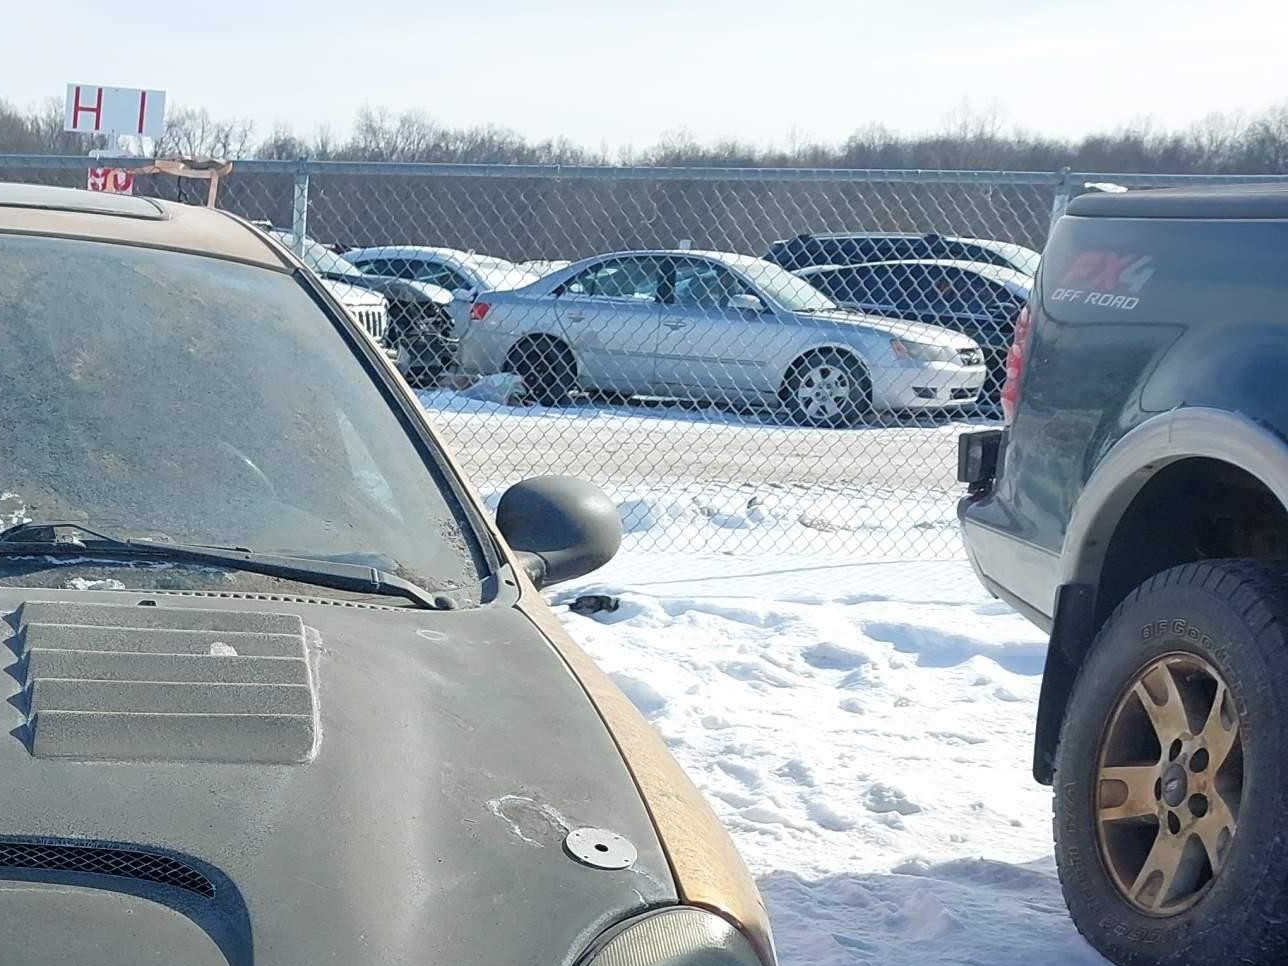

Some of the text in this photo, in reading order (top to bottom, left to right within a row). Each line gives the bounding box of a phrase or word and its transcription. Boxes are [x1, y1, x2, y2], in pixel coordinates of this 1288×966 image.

[72, 85, 103, 131] H
[1062, 250, 1155, 293] FX4
[1050, 288, 1140, 310] OFF ROAD
